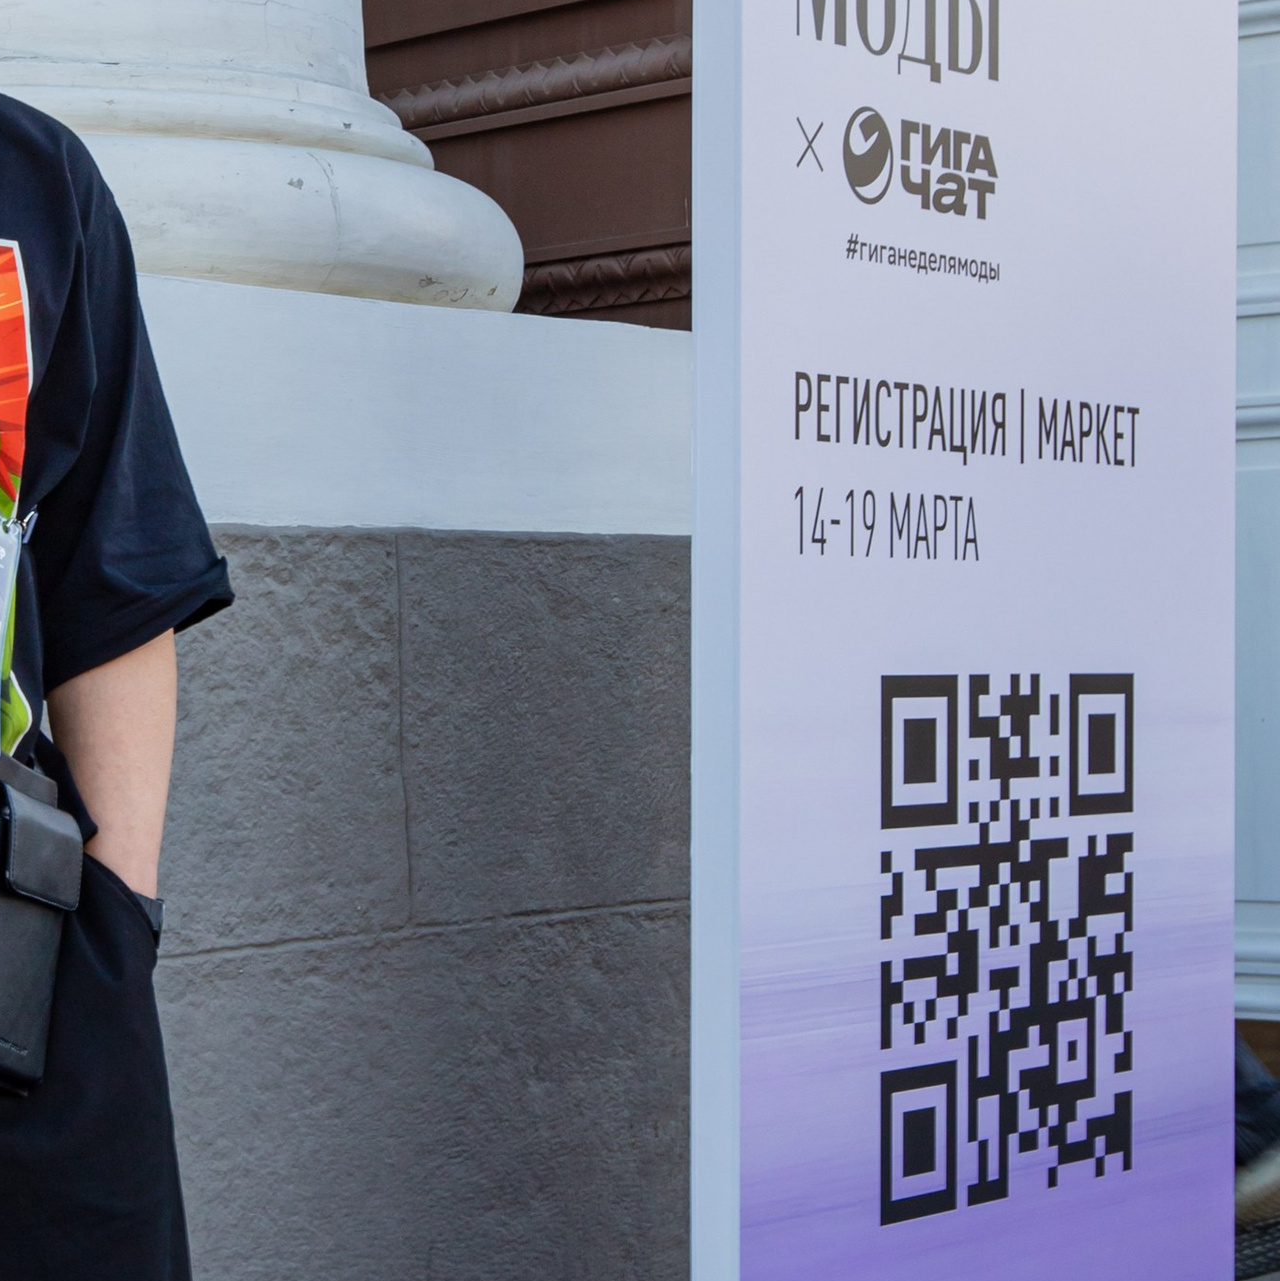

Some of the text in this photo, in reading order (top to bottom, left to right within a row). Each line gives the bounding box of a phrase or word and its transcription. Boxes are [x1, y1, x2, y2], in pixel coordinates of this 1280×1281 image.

[900, 117, 999, 179] ГИГА
[845, 232, 1001, 285] #гиганеделямоды
[793, 370, 1007, 467] РЕГИСТРАЦИЯ
[1037, 396, 1141, 468] МАРКЕТ
[793, 485, 980, 562] 14-19 МАРТА
